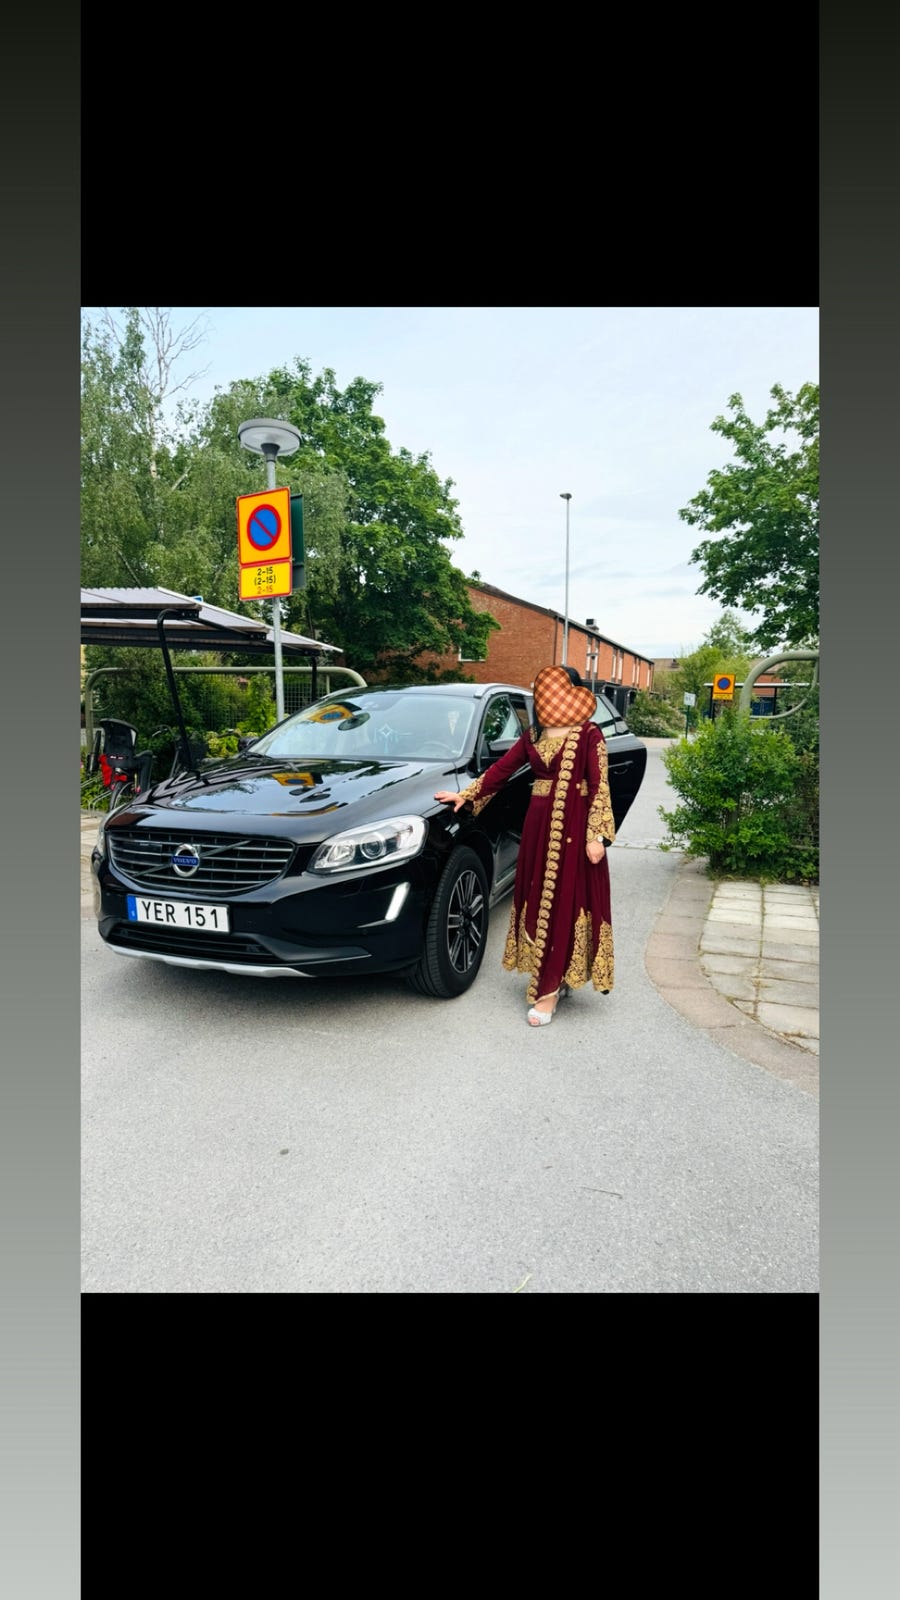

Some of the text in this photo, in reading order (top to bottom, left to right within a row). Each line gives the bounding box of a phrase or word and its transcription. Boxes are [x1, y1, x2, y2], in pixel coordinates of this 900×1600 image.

[257, 566, 273, 576] 2-15
[254, 575, 276, 586] (2-15)
[173, 857, 197, 865] VOLVO
[141, 901, 218, 928] YER 151
